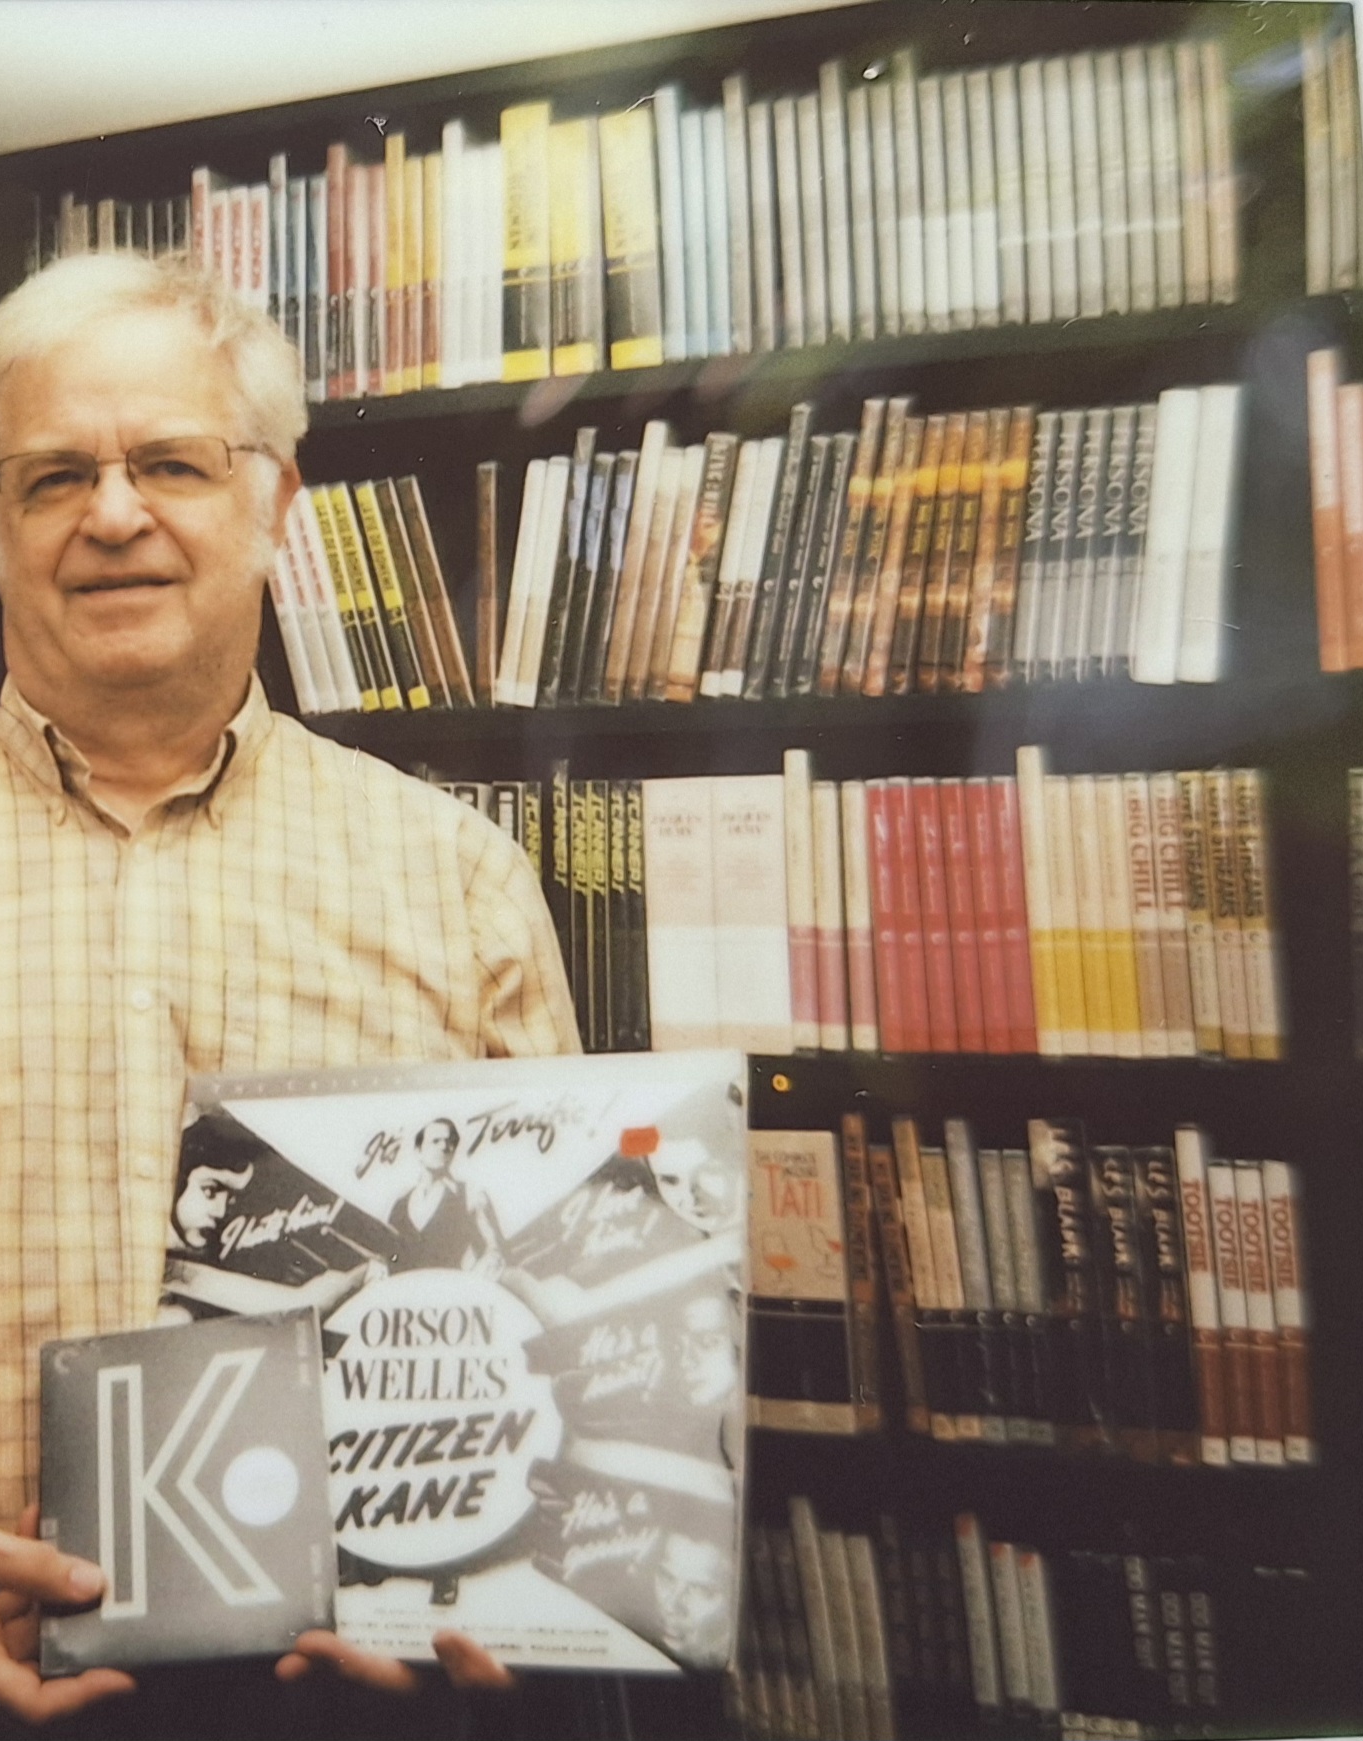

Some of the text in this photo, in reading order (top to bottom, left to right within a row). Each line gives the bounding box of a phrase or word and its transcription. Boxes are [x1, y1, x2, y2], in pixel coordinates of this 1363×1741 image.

[1129, 798, 1153, 915] BIG CHILL
[1157, 797, 1183, 914] BIG CHILL
[763, 1164, 823, 1218] TATI
[1182, 1180, 1209, 1273] TOOTSIE
[1215, 1196, 1241, 1290] TOOTSIE
[1242, 1200, 1269, 1294] TOOTSIE
[1271, 1195, 1296, 1290] TOOTSIE
[360, 1306, 494, 1348] ORSON
[339, 1358, 508, 1400] WELLES
[98, 1347, 283, 1621] K
[329, 1408, 537, 1474] CITIZEN
[335, 1470, 497, 1533] KANE
